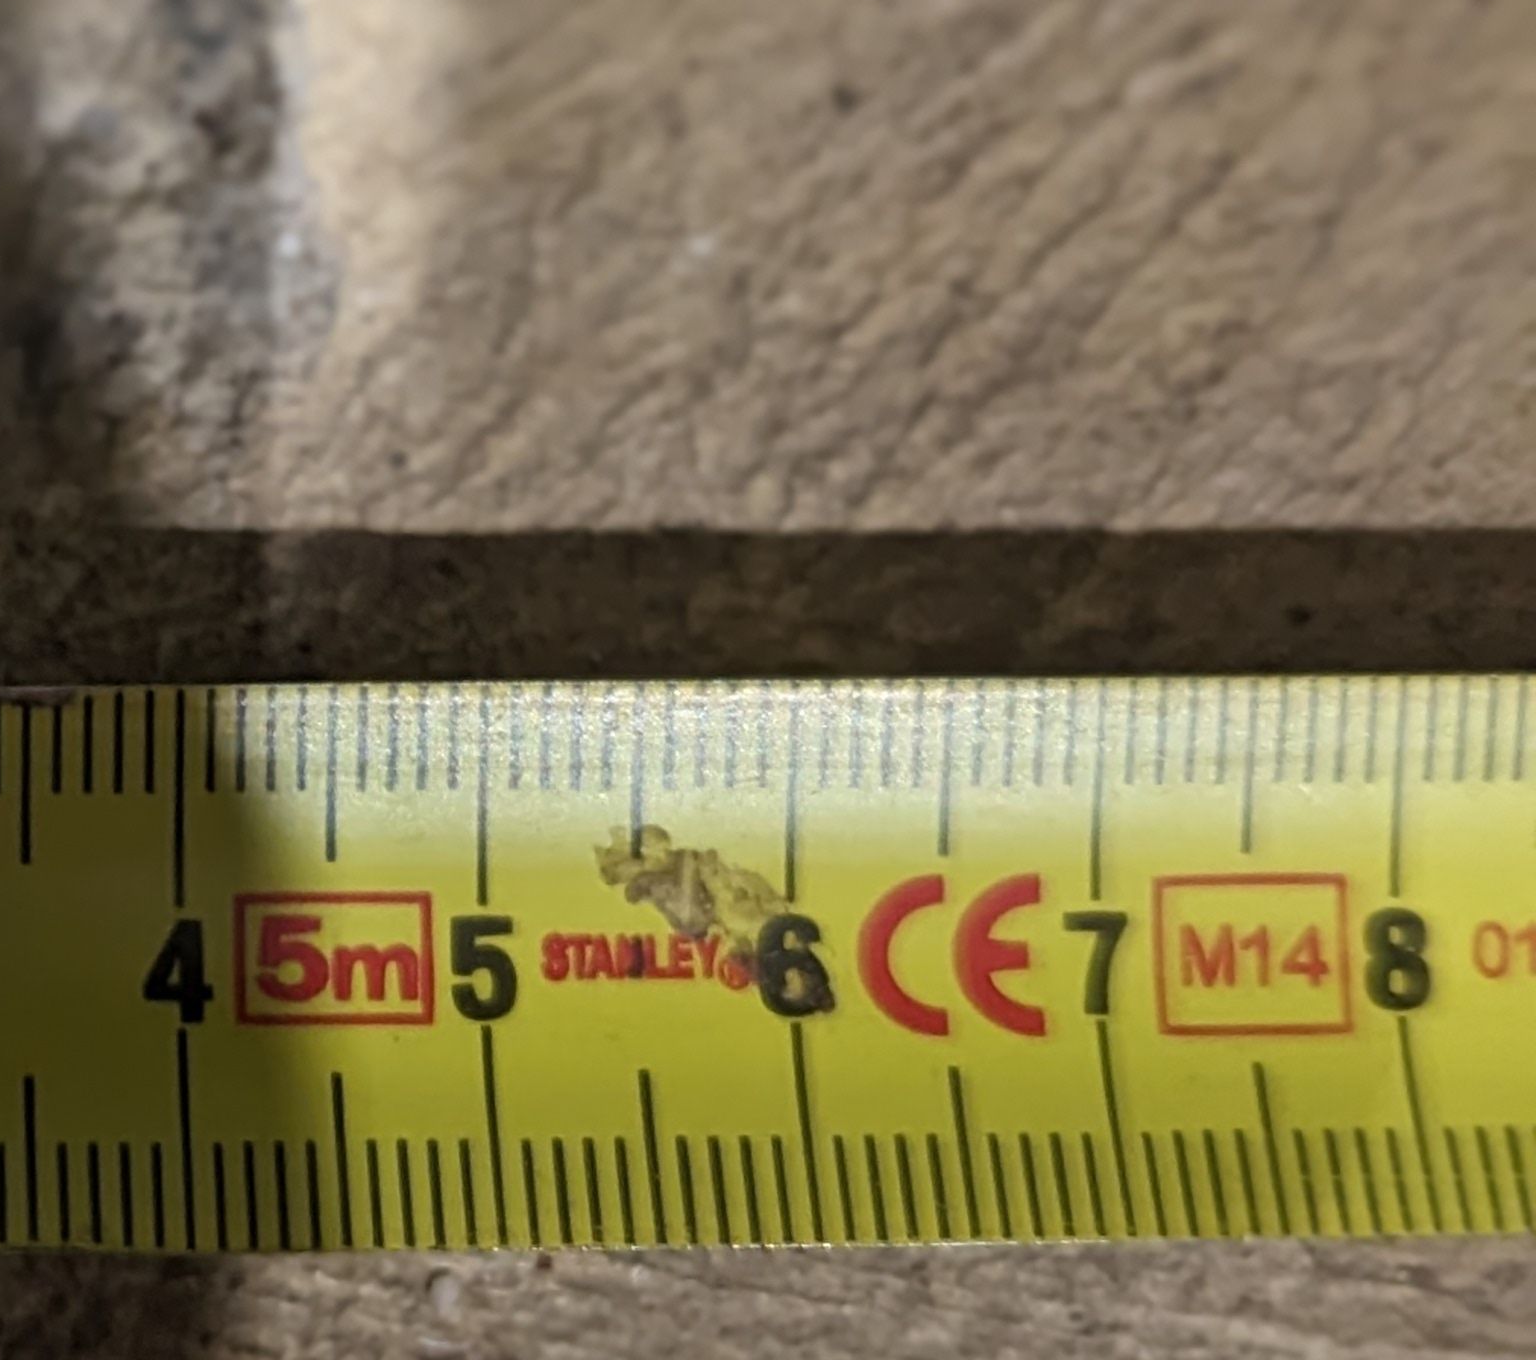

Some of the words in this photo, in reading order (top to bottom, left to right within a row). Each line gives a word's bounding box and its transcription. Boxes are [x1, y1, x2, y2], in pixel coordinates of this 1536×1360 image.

[143, 919, 213, 1023] 4
[255, 915, 419, 1001] 5m
[451, 916, 517, 1020] 5
[759, 914, 835, 1016] 6
[1063, 911, 1127, 1015] 7
[1180, 924, 1329, 987] M14
[1364, 907, 1431, 1011] 8
